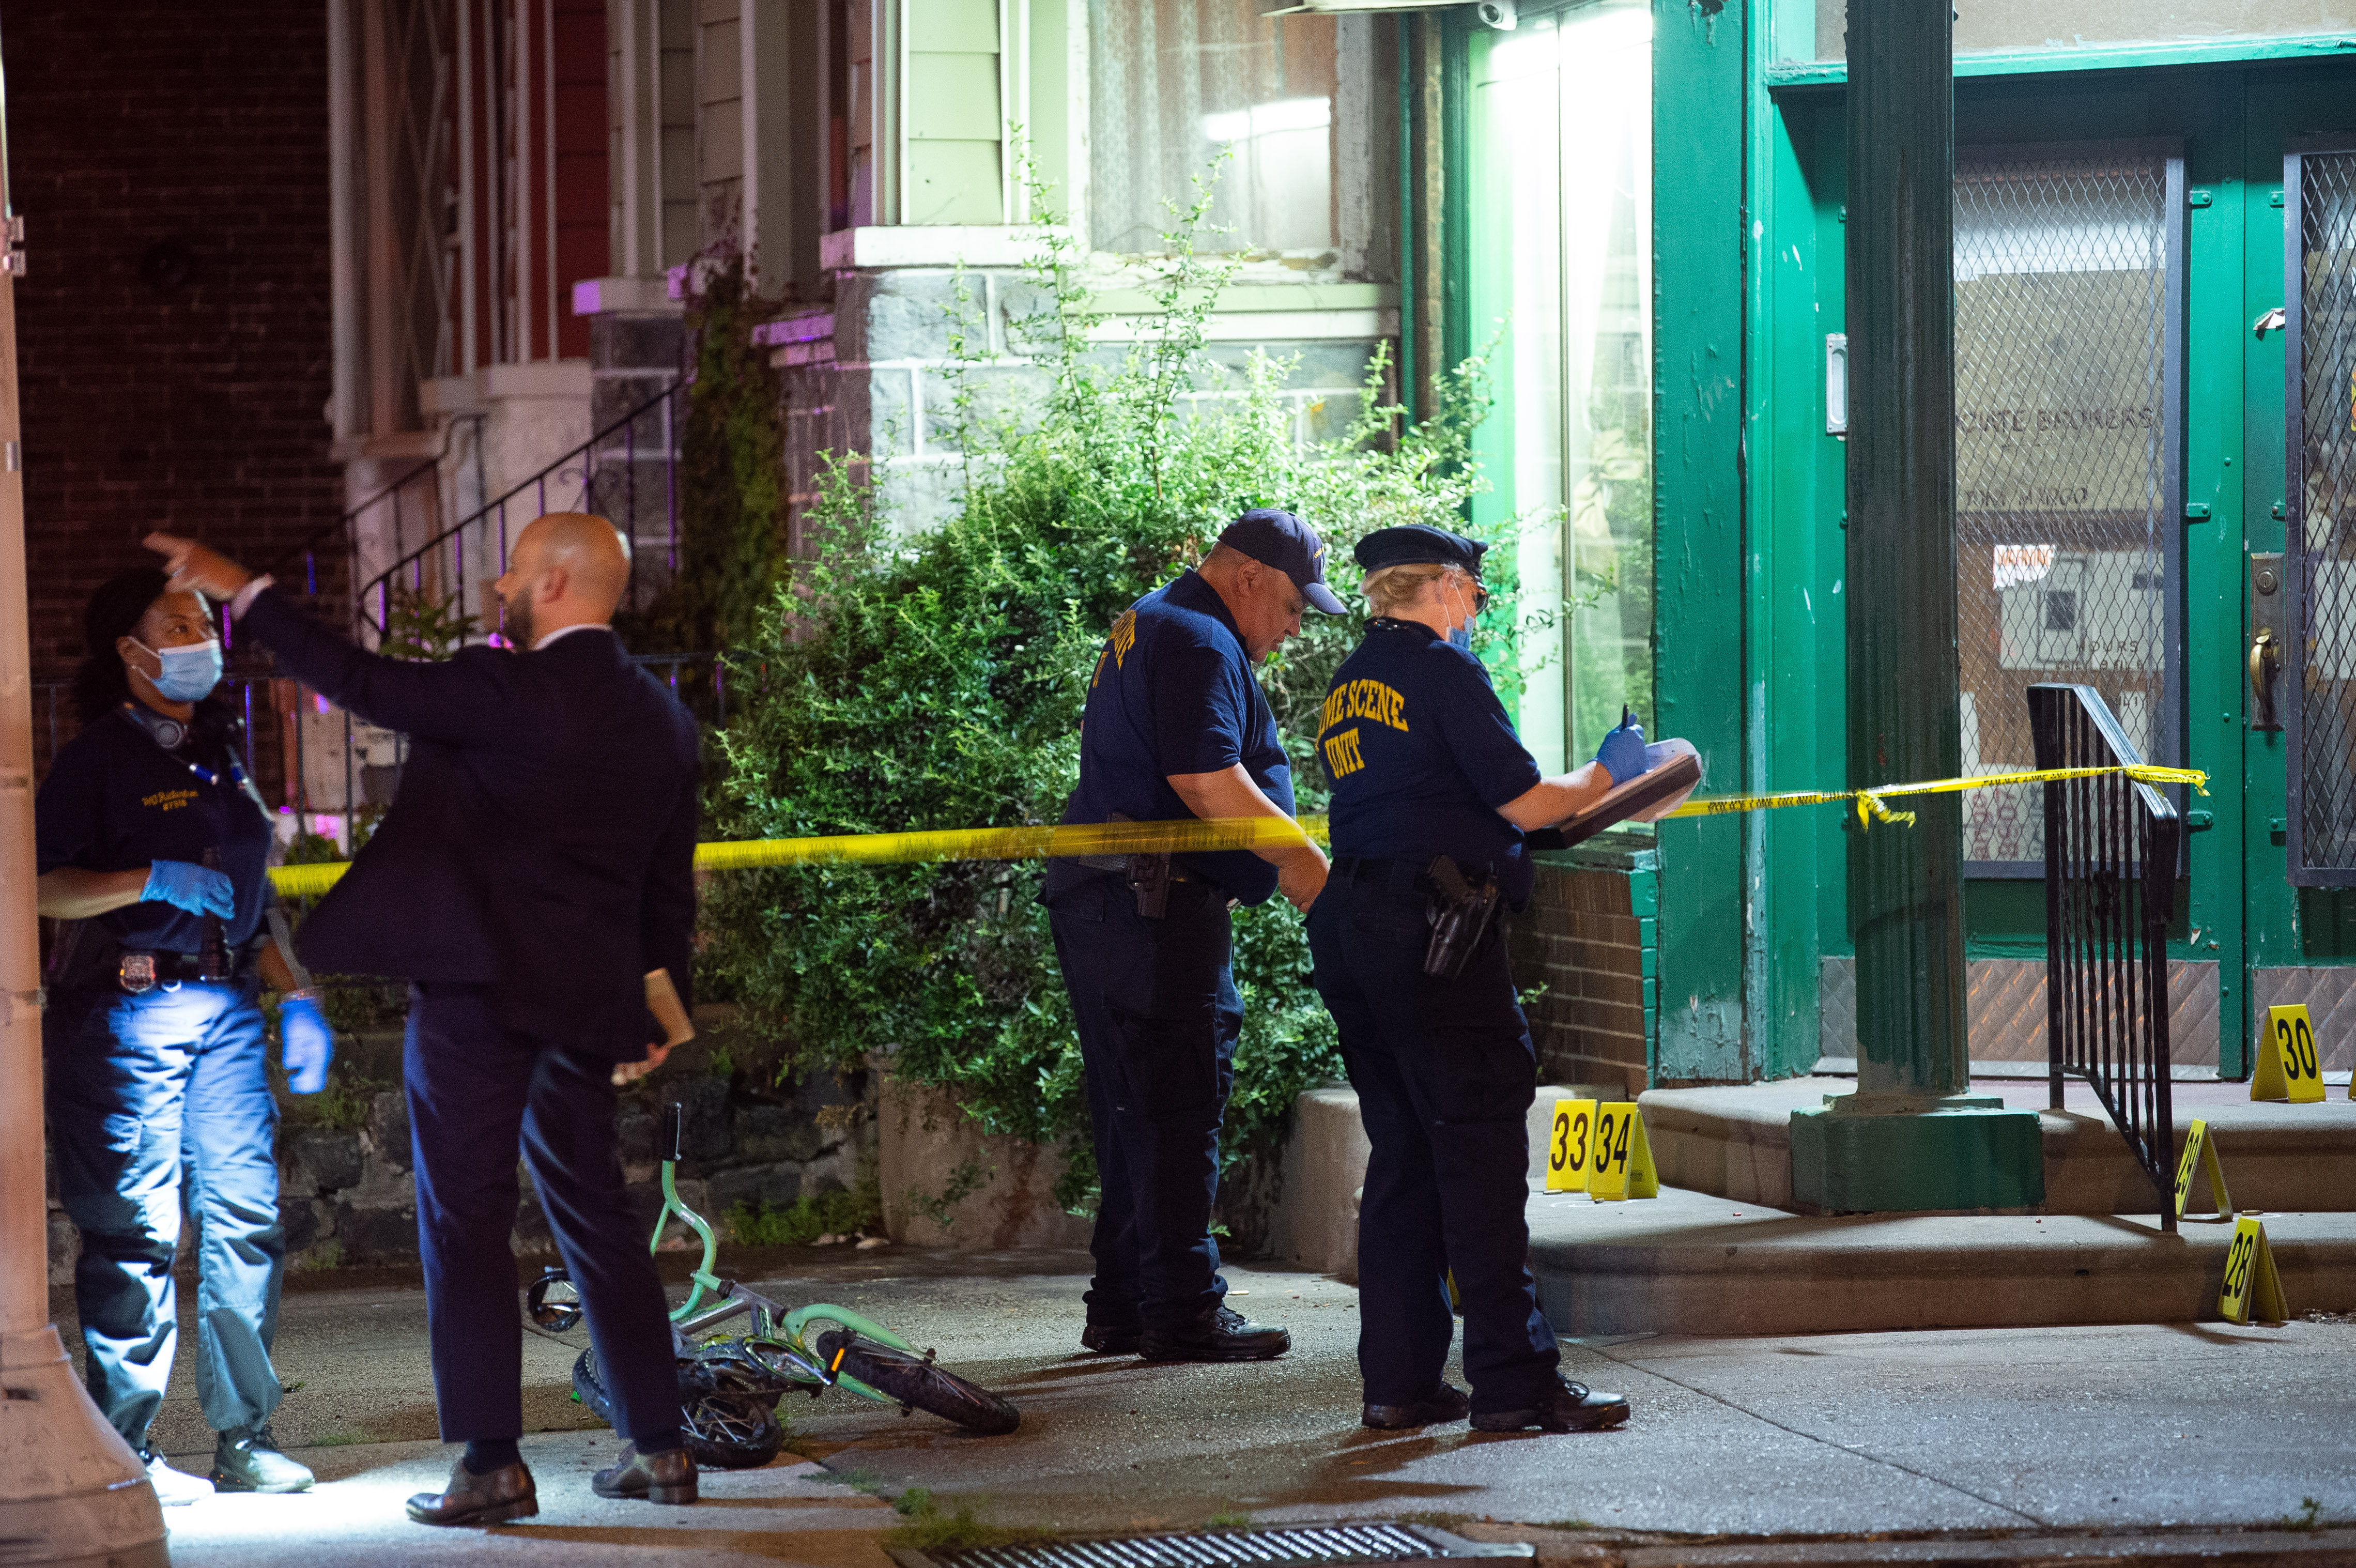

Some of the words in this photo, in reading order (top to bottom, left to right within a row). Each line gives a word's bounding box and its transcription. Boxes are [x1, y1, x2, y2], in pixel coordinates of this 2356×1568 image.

[1997, 548, 2053, 567] WARNING
[2076, 640, 2138, 653] HOURS
[1346, 679, 1410, 732] SCENE
[1325, 727, 1365, 779] UNIT
[2277, 1018, 2317, 1081] 30
[1551, 1113, 1588, 1171] 33
[1596, 1113, 1631, 1174] 34
[2175, 1131, 2200, 1196] 29
[2222, 1232, 2254, 1299] 28
